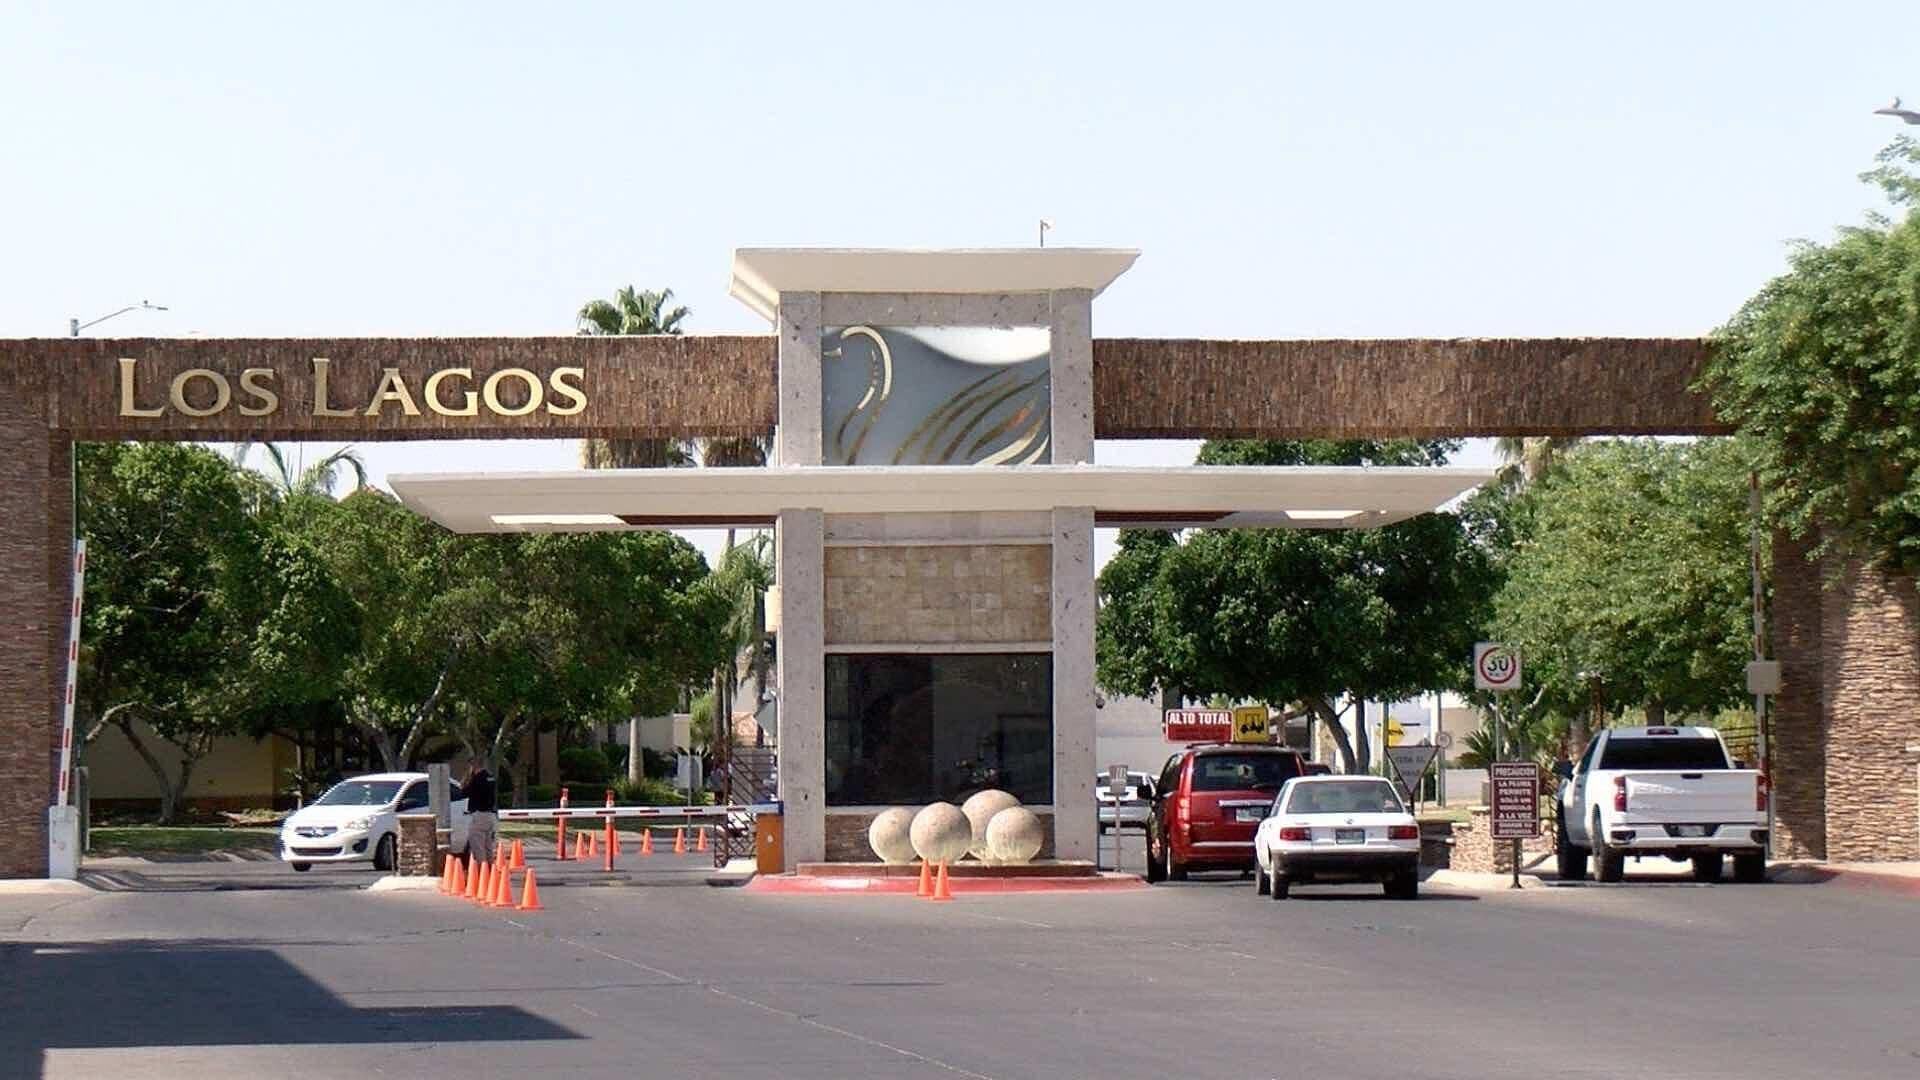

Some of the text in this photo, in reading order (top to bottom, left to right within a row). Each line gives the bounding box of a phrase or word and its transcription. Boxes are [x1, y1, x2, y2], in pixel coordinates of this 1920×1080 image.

[119, 358, 588, 418] LOS LAGOS
[1487, 656, 1509, 671] 30
[1169, 712, 1231, 724] ALTO TOTAL
[1498, 788, 1532, 796] PERMITE
